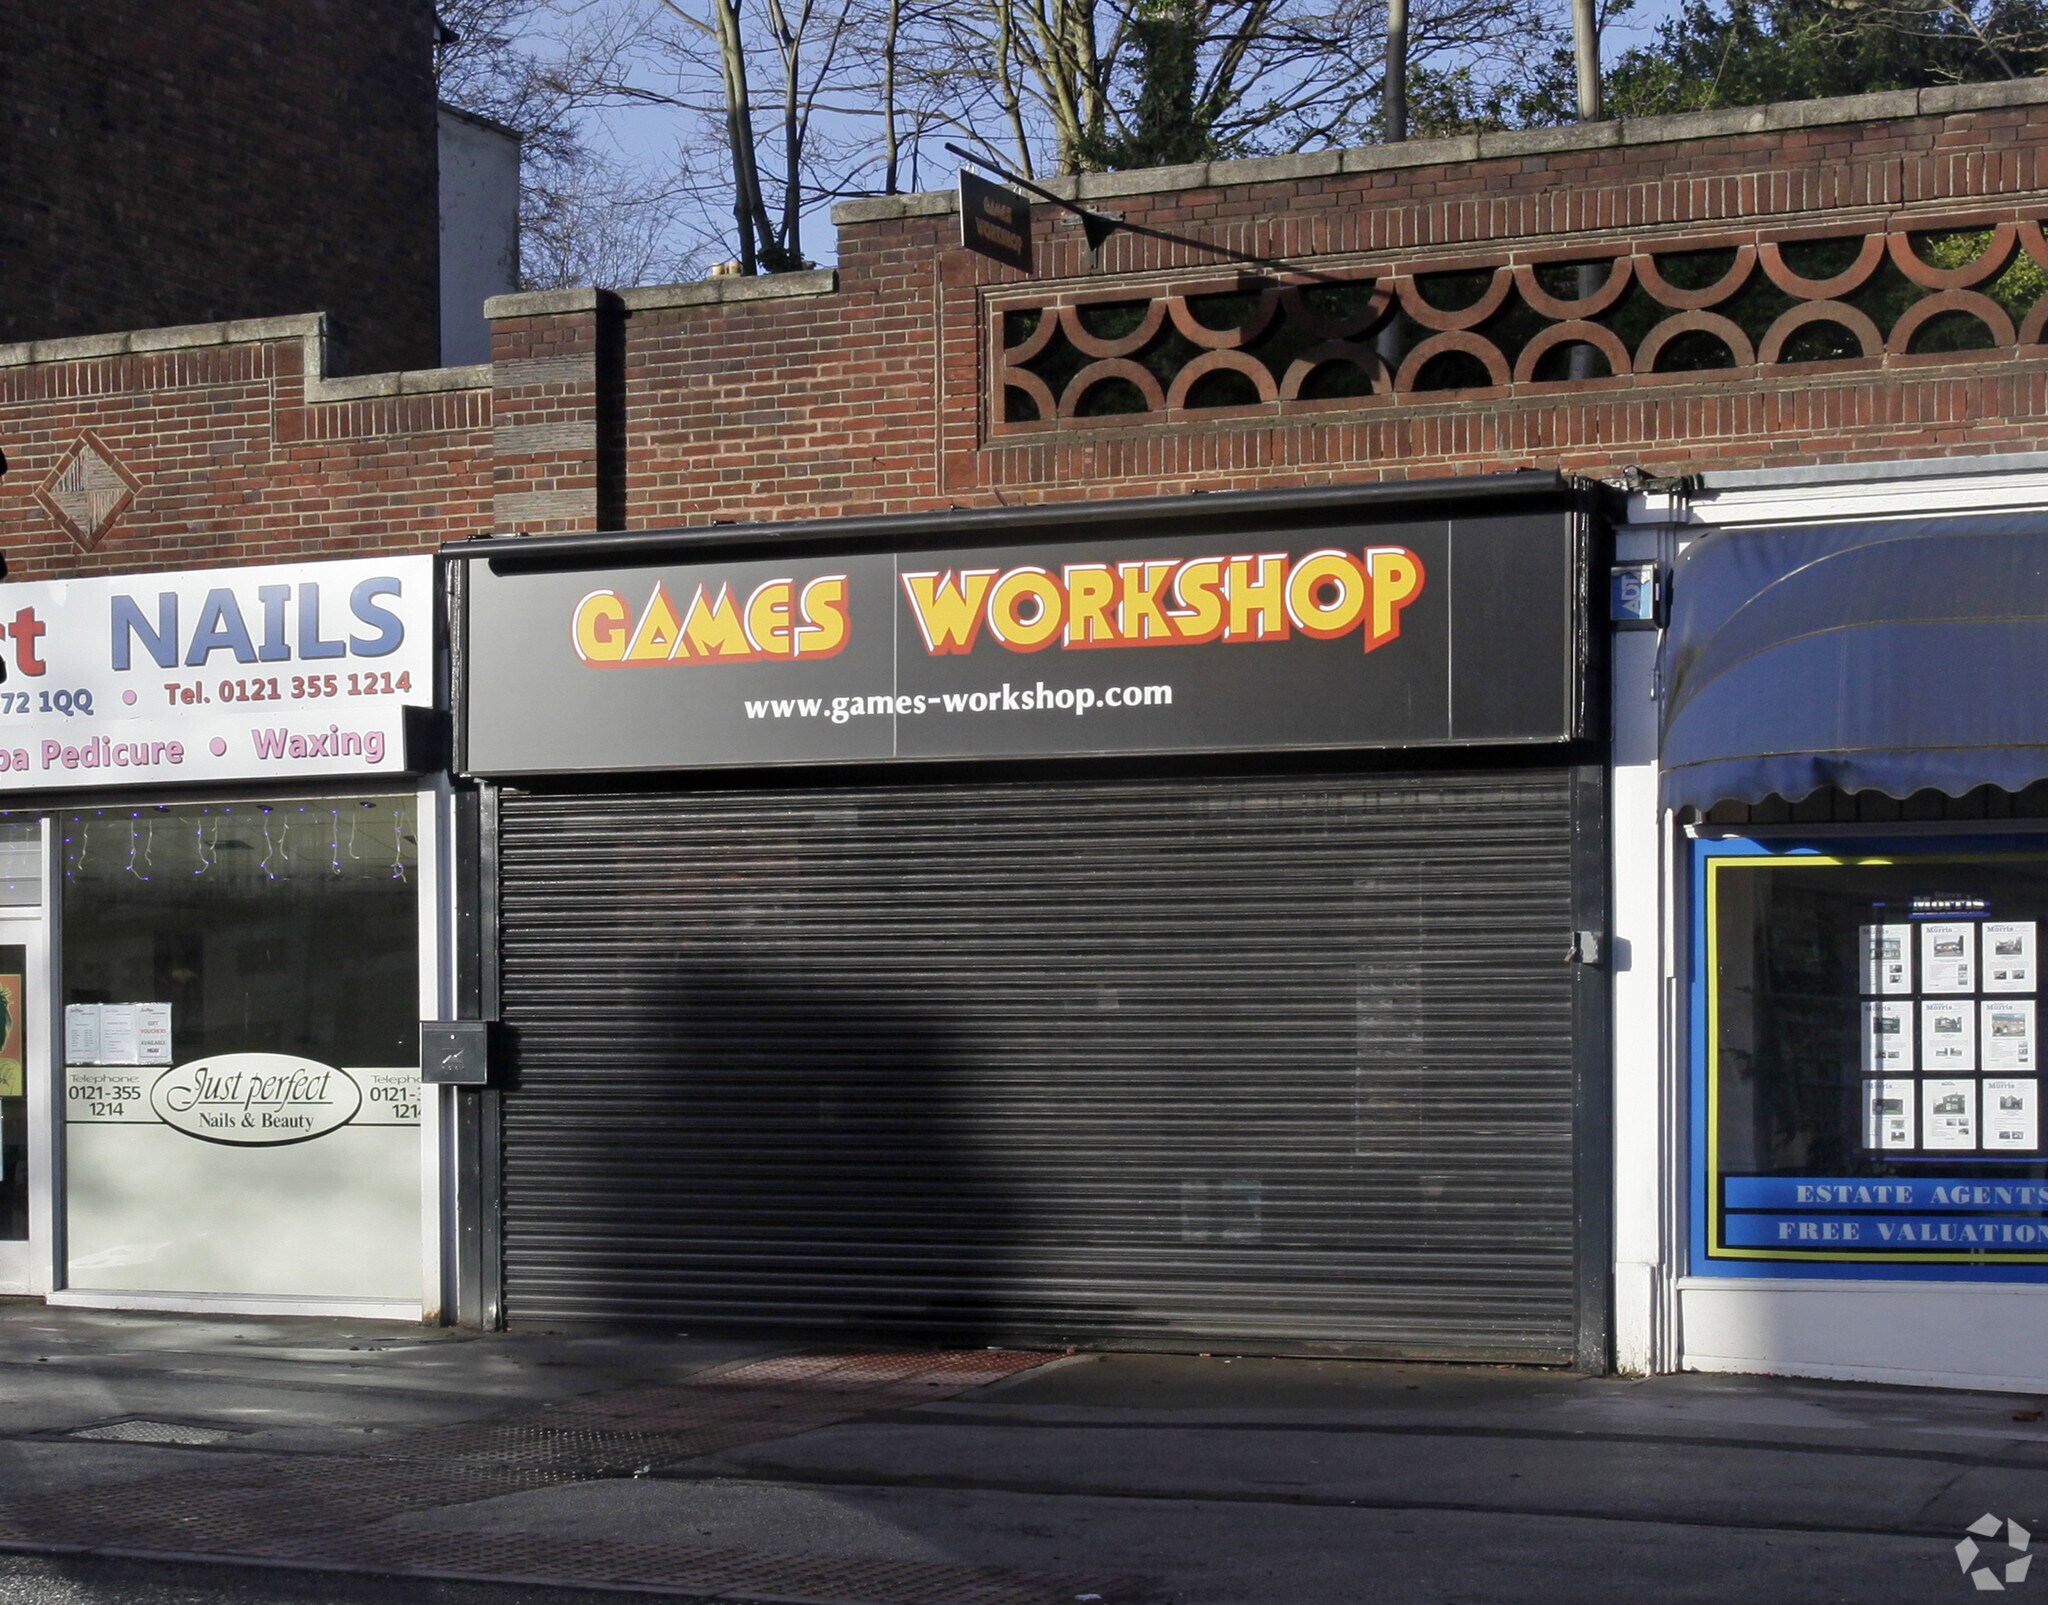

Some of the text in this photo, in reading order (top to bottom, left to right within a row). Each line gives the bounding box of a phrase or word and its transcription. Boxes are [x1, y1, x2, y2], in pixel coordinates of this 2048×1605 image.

[569, 544, 1425, 671] GAMES WORKSHOP
[1620, 574, 1641, 615] ADT
[0, 576, 406, 677] t NAILS
[38, 687, 95, 717] 1QQ
[164, 682, 211, 706] Tel.
[218, 677, 282, 703] 0121
[290, 673, 338, 699] 355
[347, 670, 412, 696] 1214
[744, 681, 1172, 724] www.games-workshop.com
[41, 735, 184, 770] Pedicure
[251, 724, 386, 764] Waxing
[68, 1085, 142, 1100] 0121-355
[88, 1102, 125, 1116] 1214
[166, 1067, 332, 1113] Just perfect
[199, 1112, 315, 1132] Nails & Beauty
[1796, 1185, 1913, 1204] ESTATE
[1778, 1222, 1860, 1240] FREE
